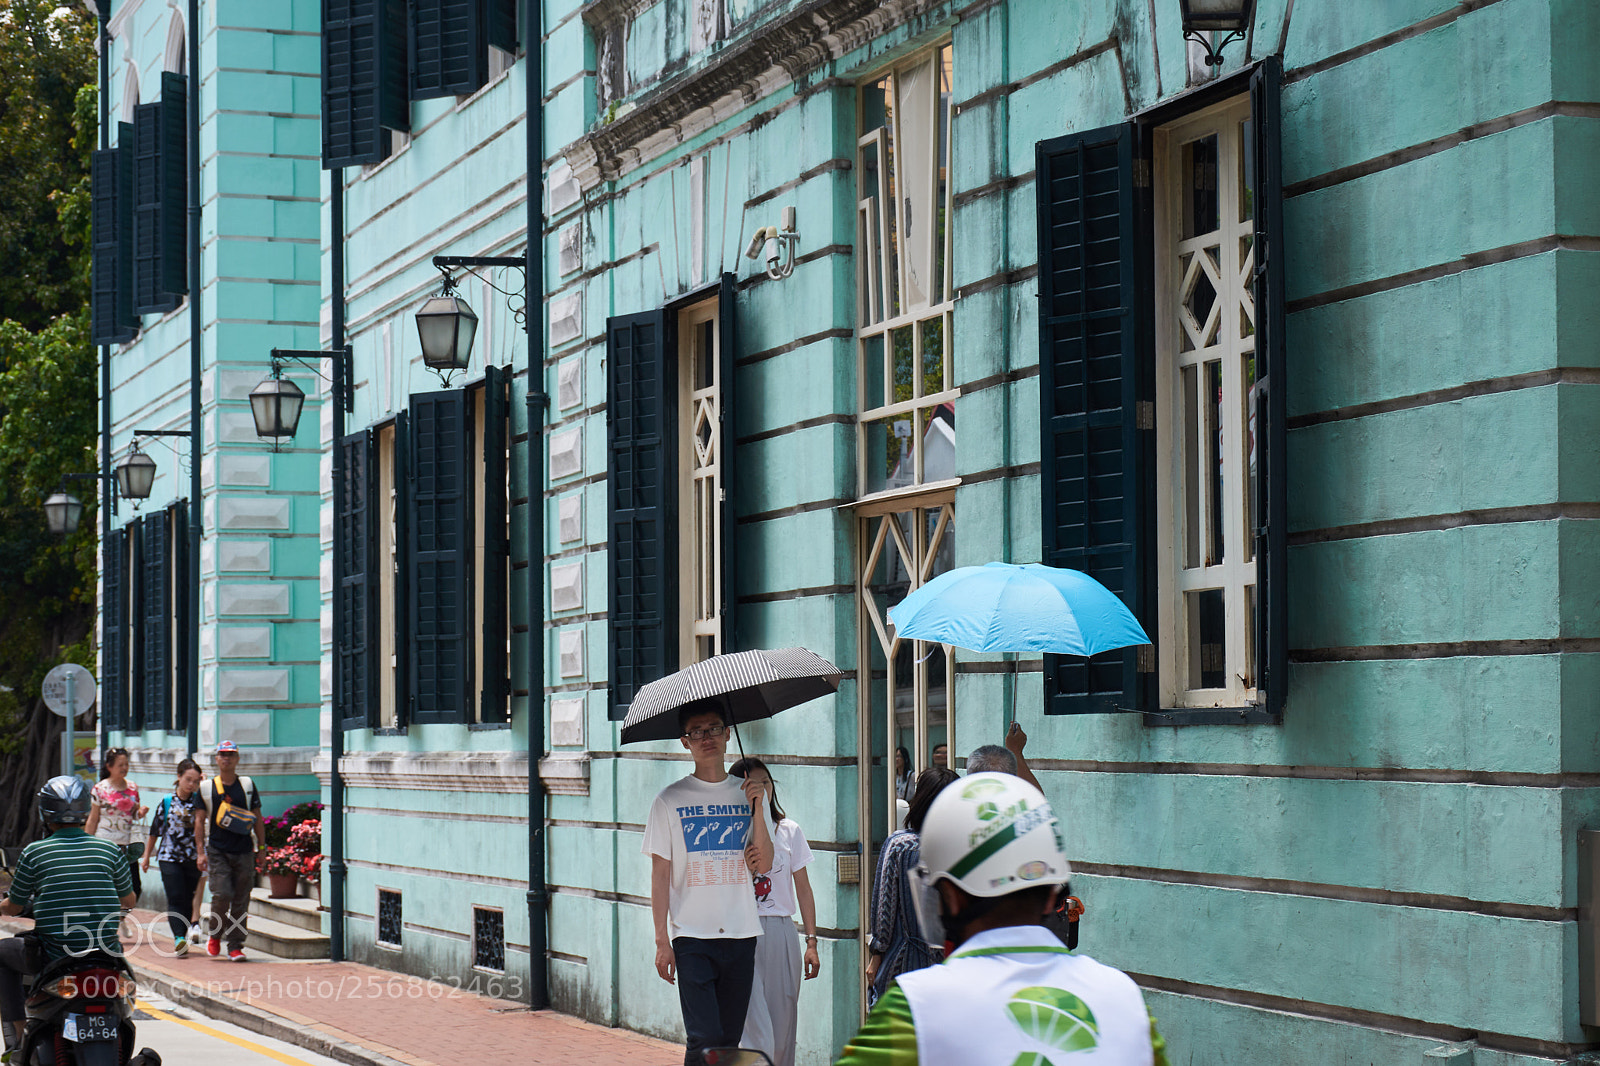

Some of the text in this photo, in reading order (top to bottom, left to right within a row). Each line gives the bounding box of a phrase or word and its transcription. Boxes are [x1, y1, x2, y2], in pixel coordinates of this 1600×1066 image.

[676, 804, 751, 818] THE SMITH
[89, 1016, 105, 1027] MG
[78, 1027, 118, 1040] 64-64
